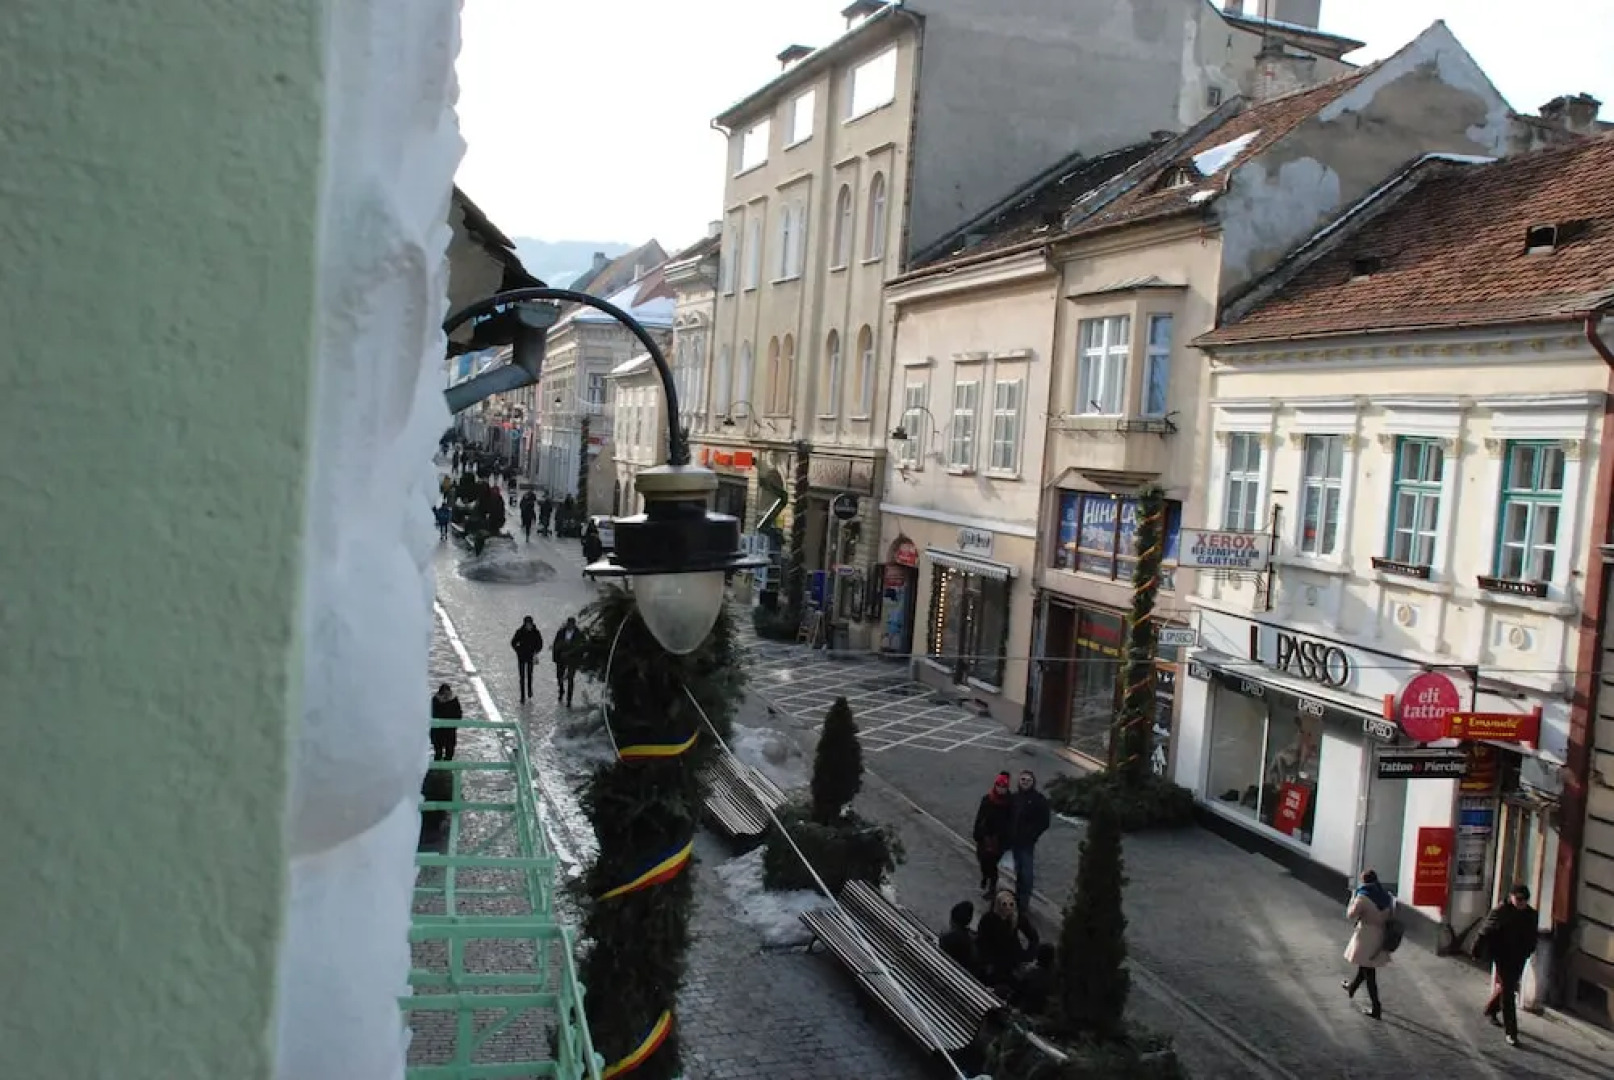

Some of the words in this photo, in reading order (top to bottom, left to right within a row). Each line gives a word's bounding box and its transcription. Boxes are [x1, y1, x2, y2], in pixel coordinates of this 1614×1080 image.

[1196, 533, 1255, 549] XEROX
[1277, 632, 1348, 686] PASSO
[1418, 687, 1440, 703] eli
[1380, 761, 1413, 772] Tattoo
